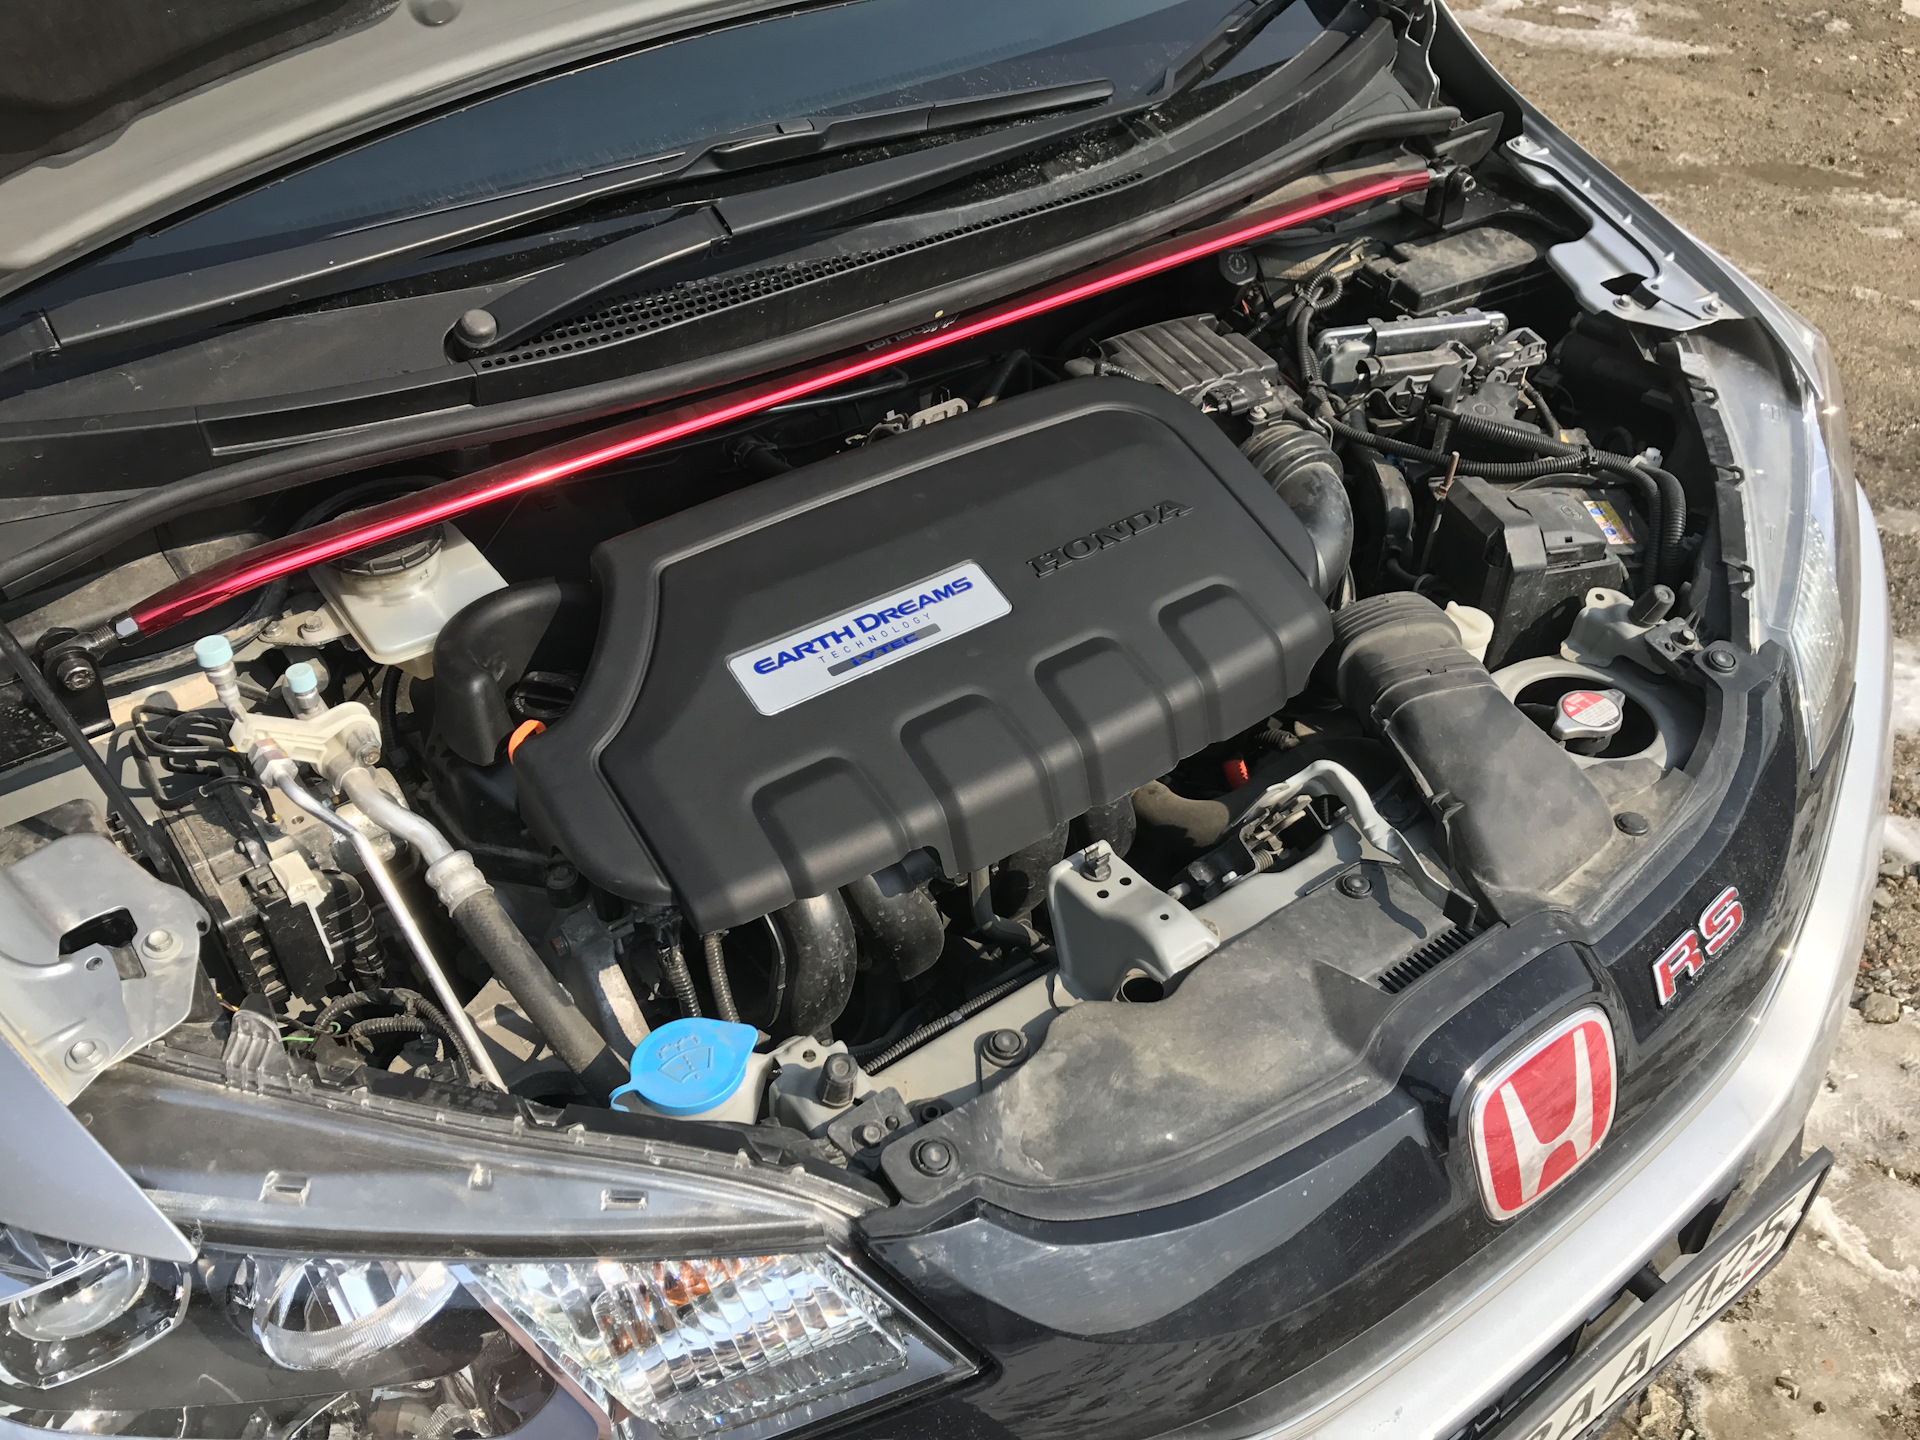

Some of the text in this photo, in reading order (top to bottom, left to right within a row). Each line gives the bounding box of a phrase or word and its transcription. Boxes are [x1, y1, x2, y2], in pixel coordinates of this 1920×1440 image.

[1026, 500, 1194, 578] HONDA
[753, 576, 974, 675] EARTH DREAMS
[818, 612, 931, 664] TECHNOLOGY
[1652, 886, 1746, 1006] RS
